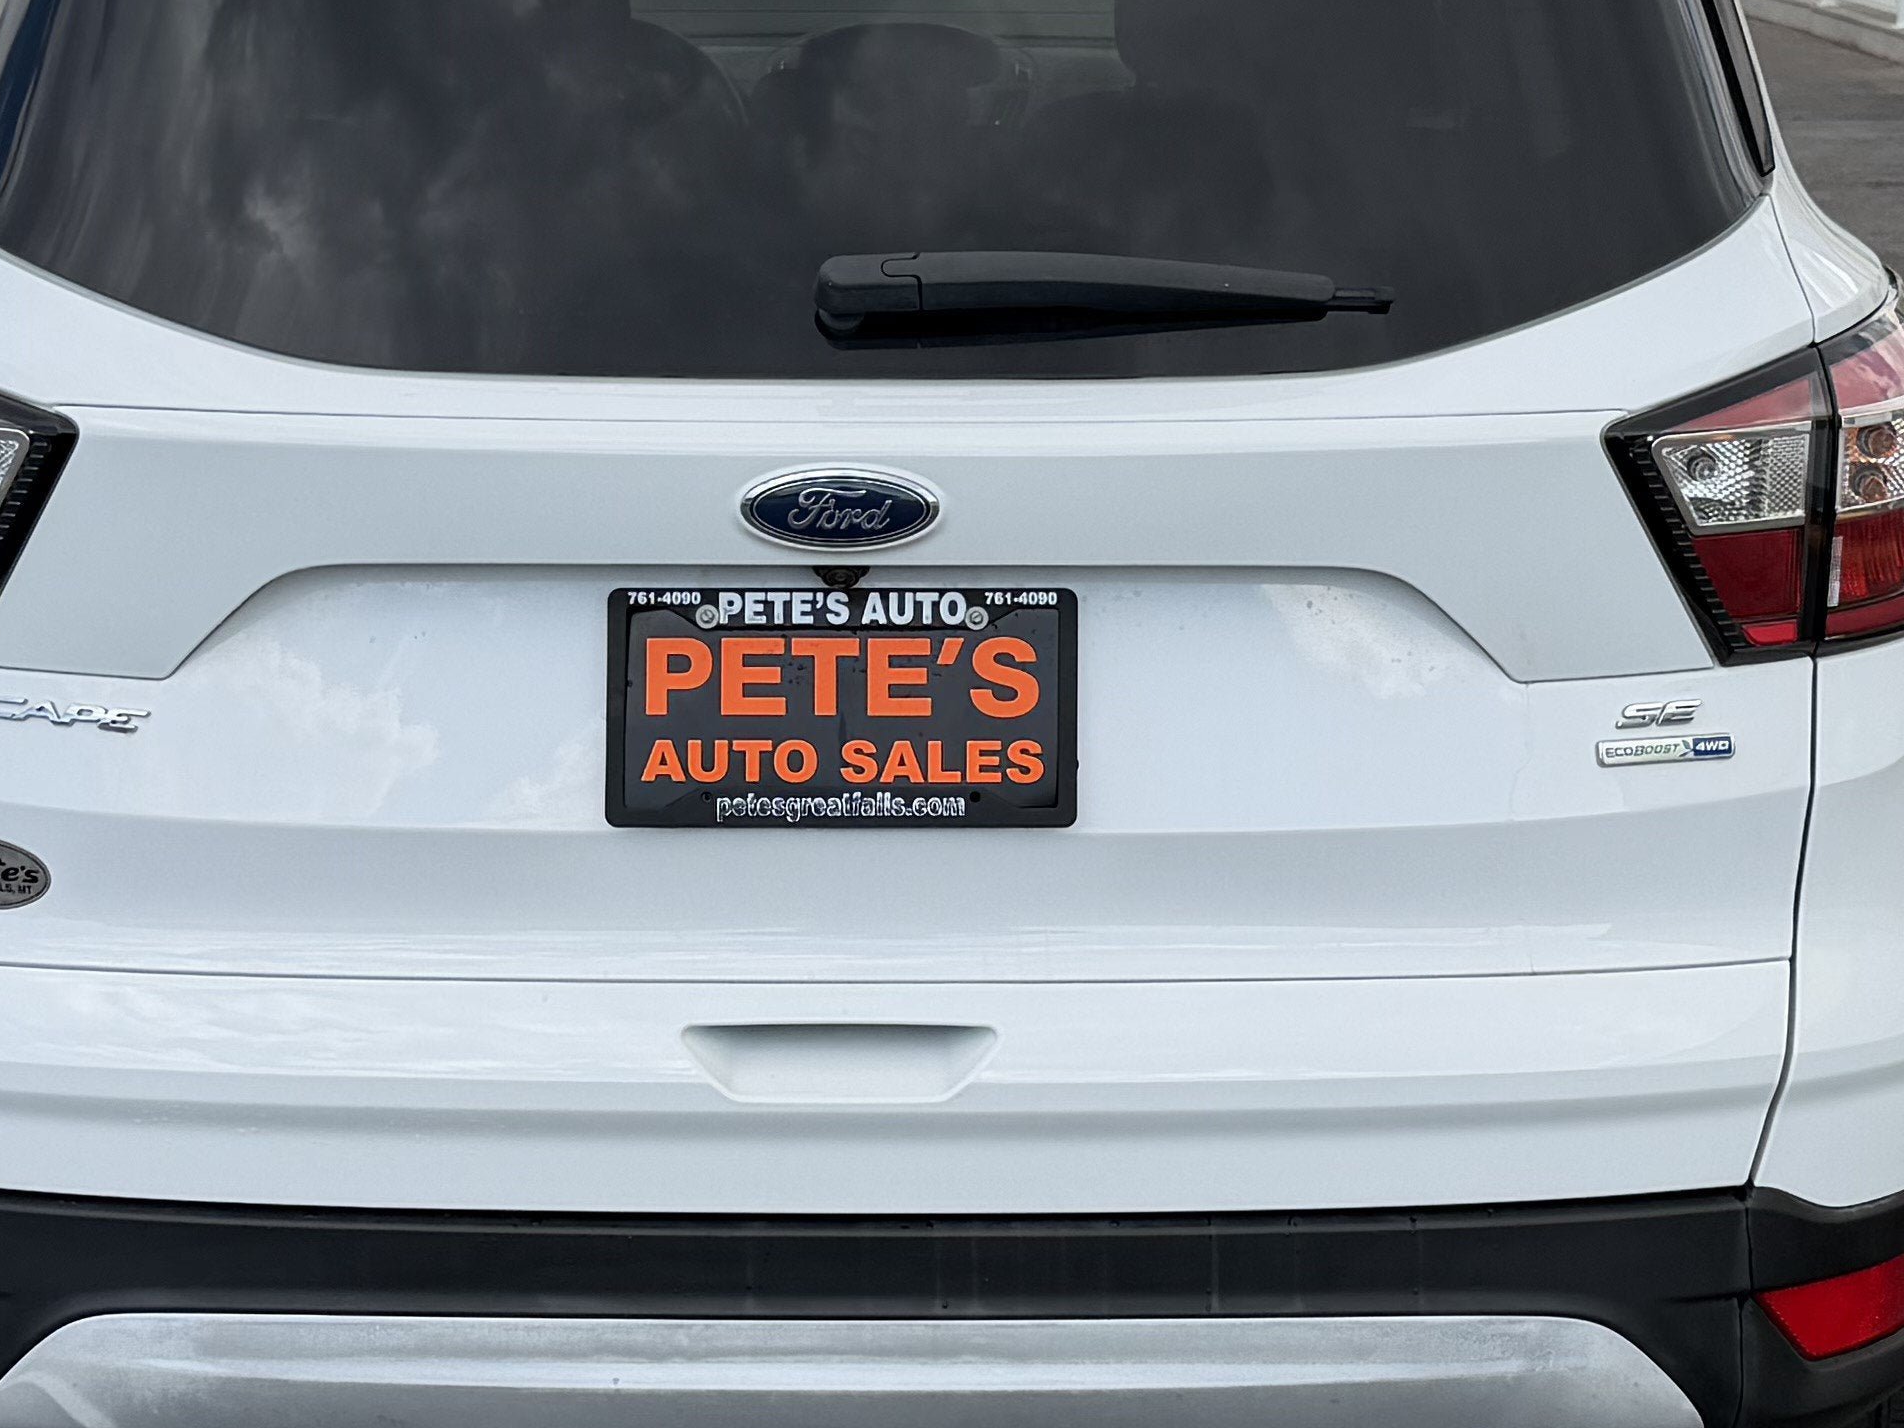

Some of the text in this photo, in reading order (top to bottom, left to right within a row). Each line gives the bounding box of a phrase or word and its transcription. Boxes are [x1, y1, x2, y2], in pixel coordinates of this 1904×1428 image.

[787, 487, 893, 531] Ford
[627, 591, 1058, 626] 761-4090 PETE'S AUTO 761-4090
[645, 636, 1041, 718] PETE'S
[1615, 699, 1702, 730] SE
[641, 739, 1044, 784] AUTO SALES
[1694, 740, 1729, 752] 4WD
